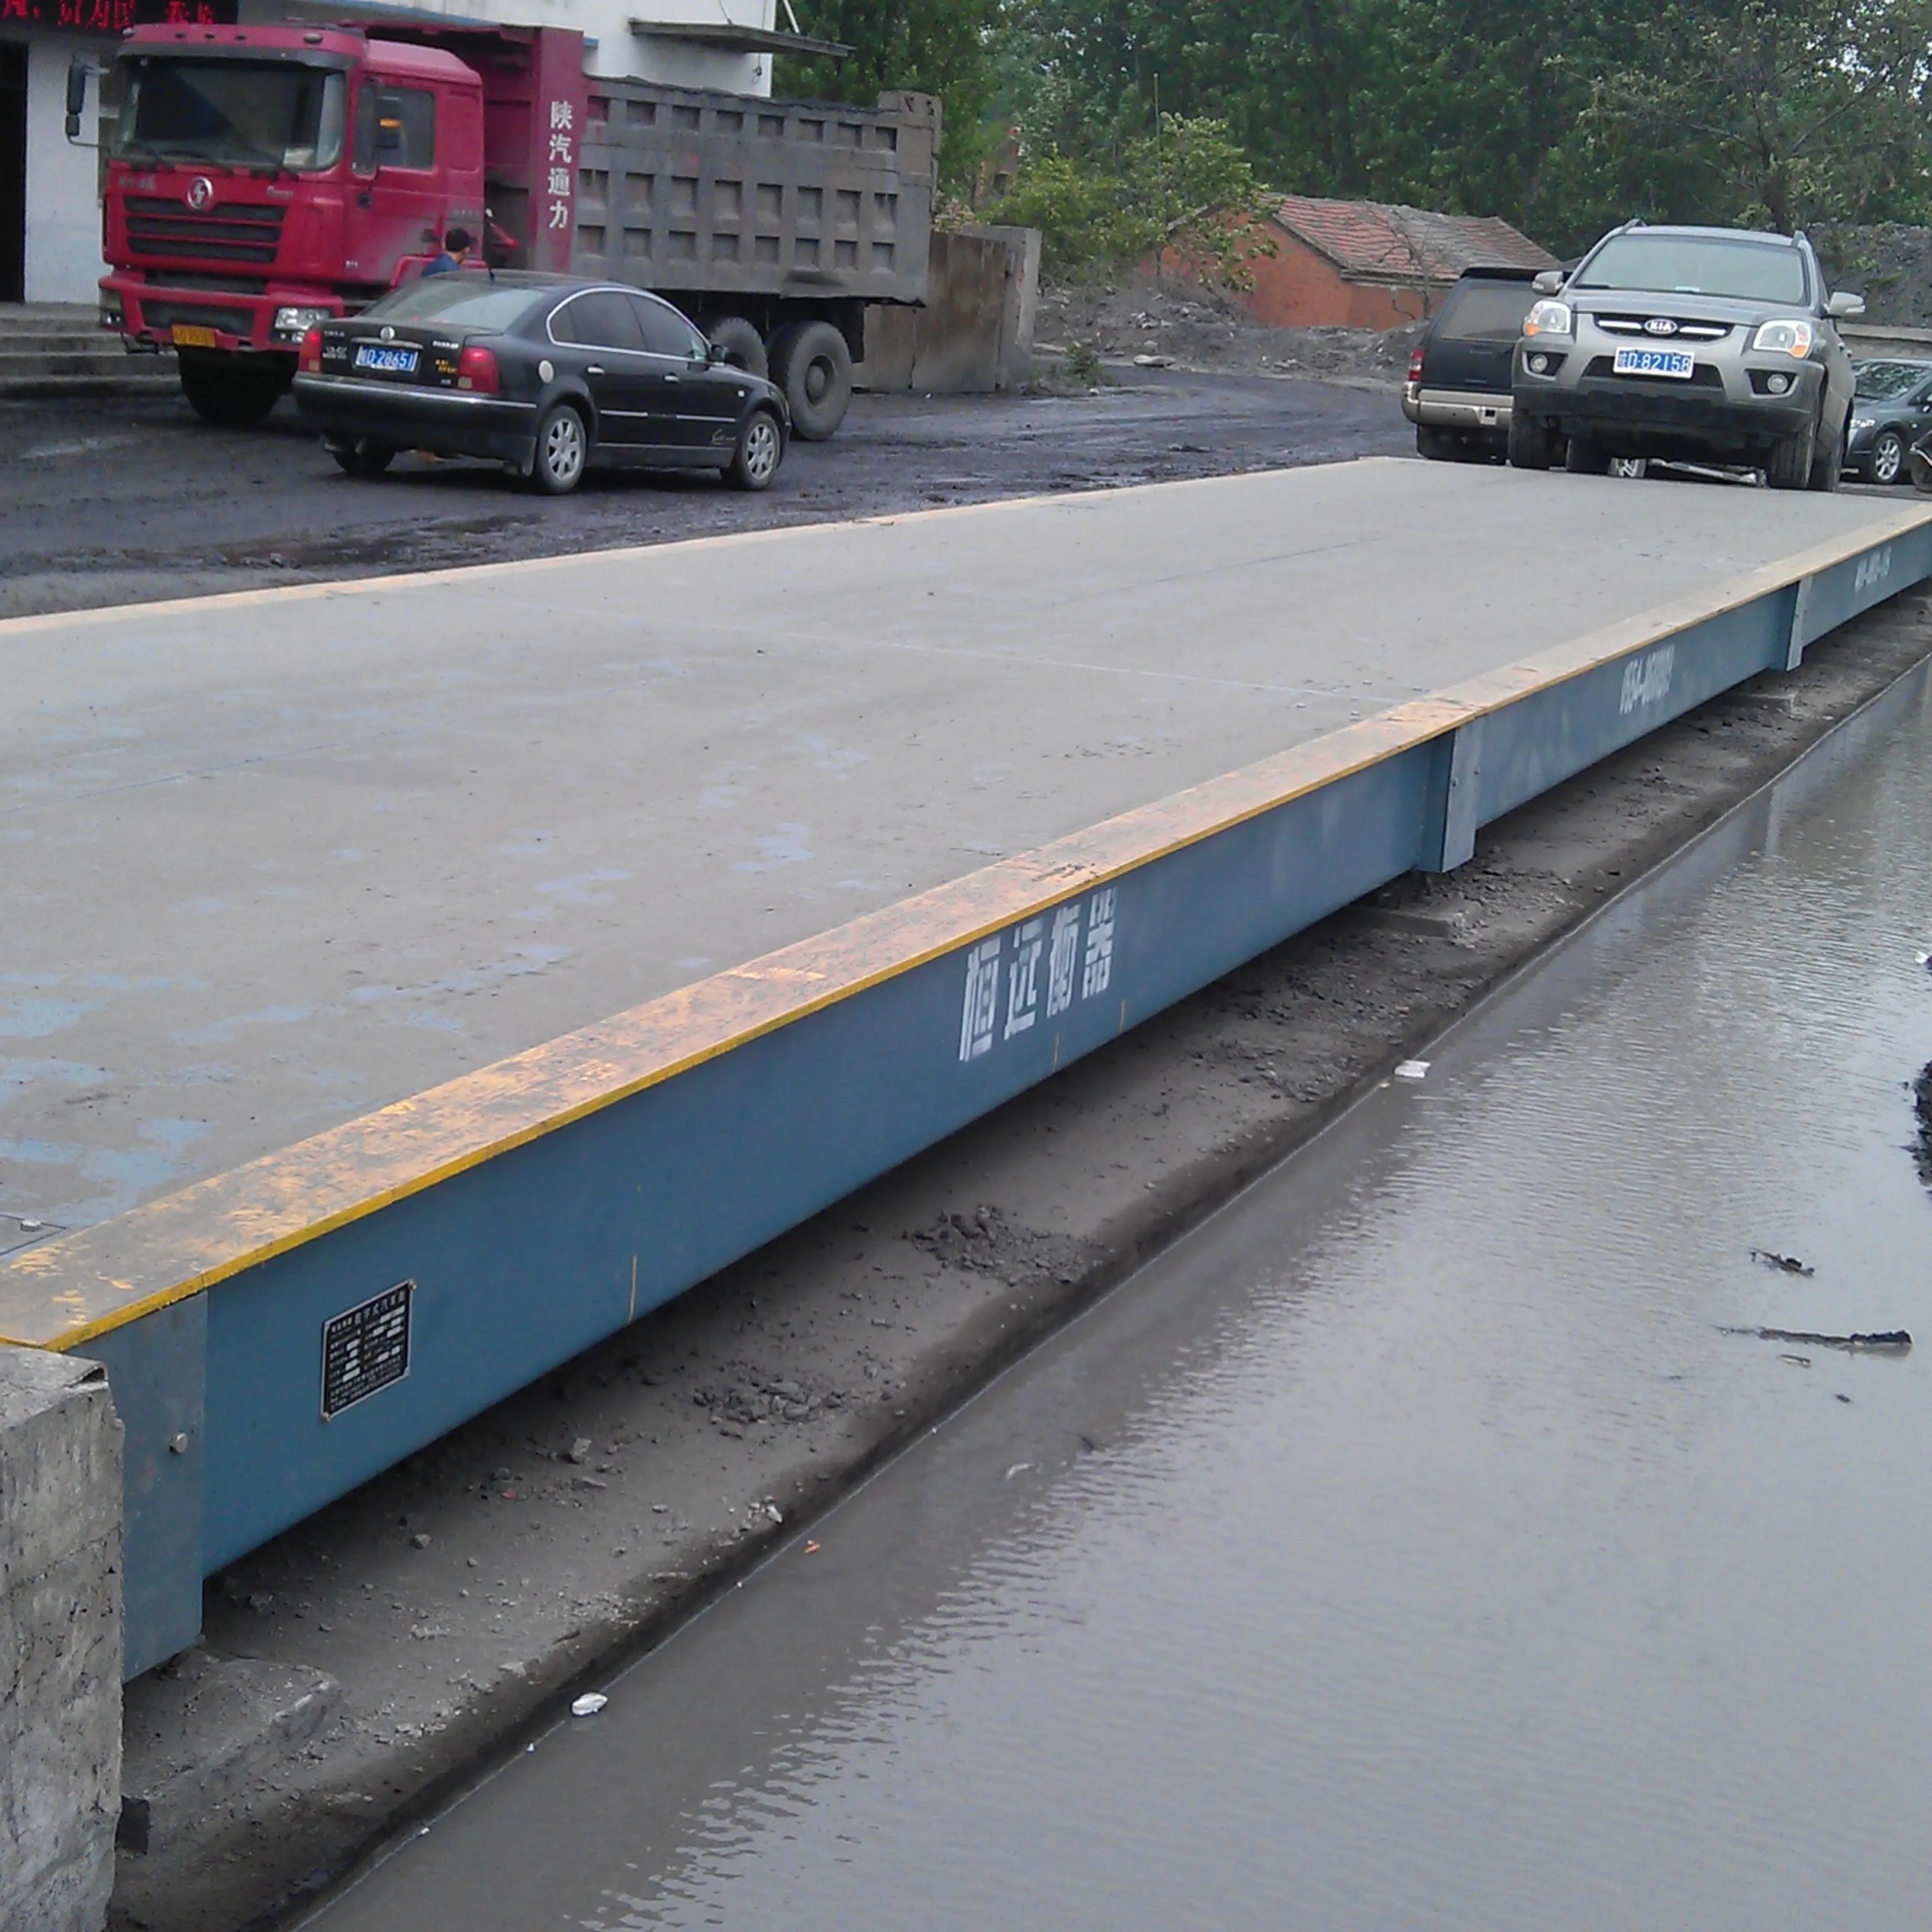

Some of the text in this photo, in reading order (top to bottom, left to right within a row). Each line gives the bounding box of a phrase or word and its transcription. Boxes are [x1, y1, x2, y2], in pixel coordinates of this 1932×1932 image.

[547, 100, 573, 230] 陕汽通力
[1649, 320, 1672, 332] KIA
[1617, 352, 1691, 373] D·82158
